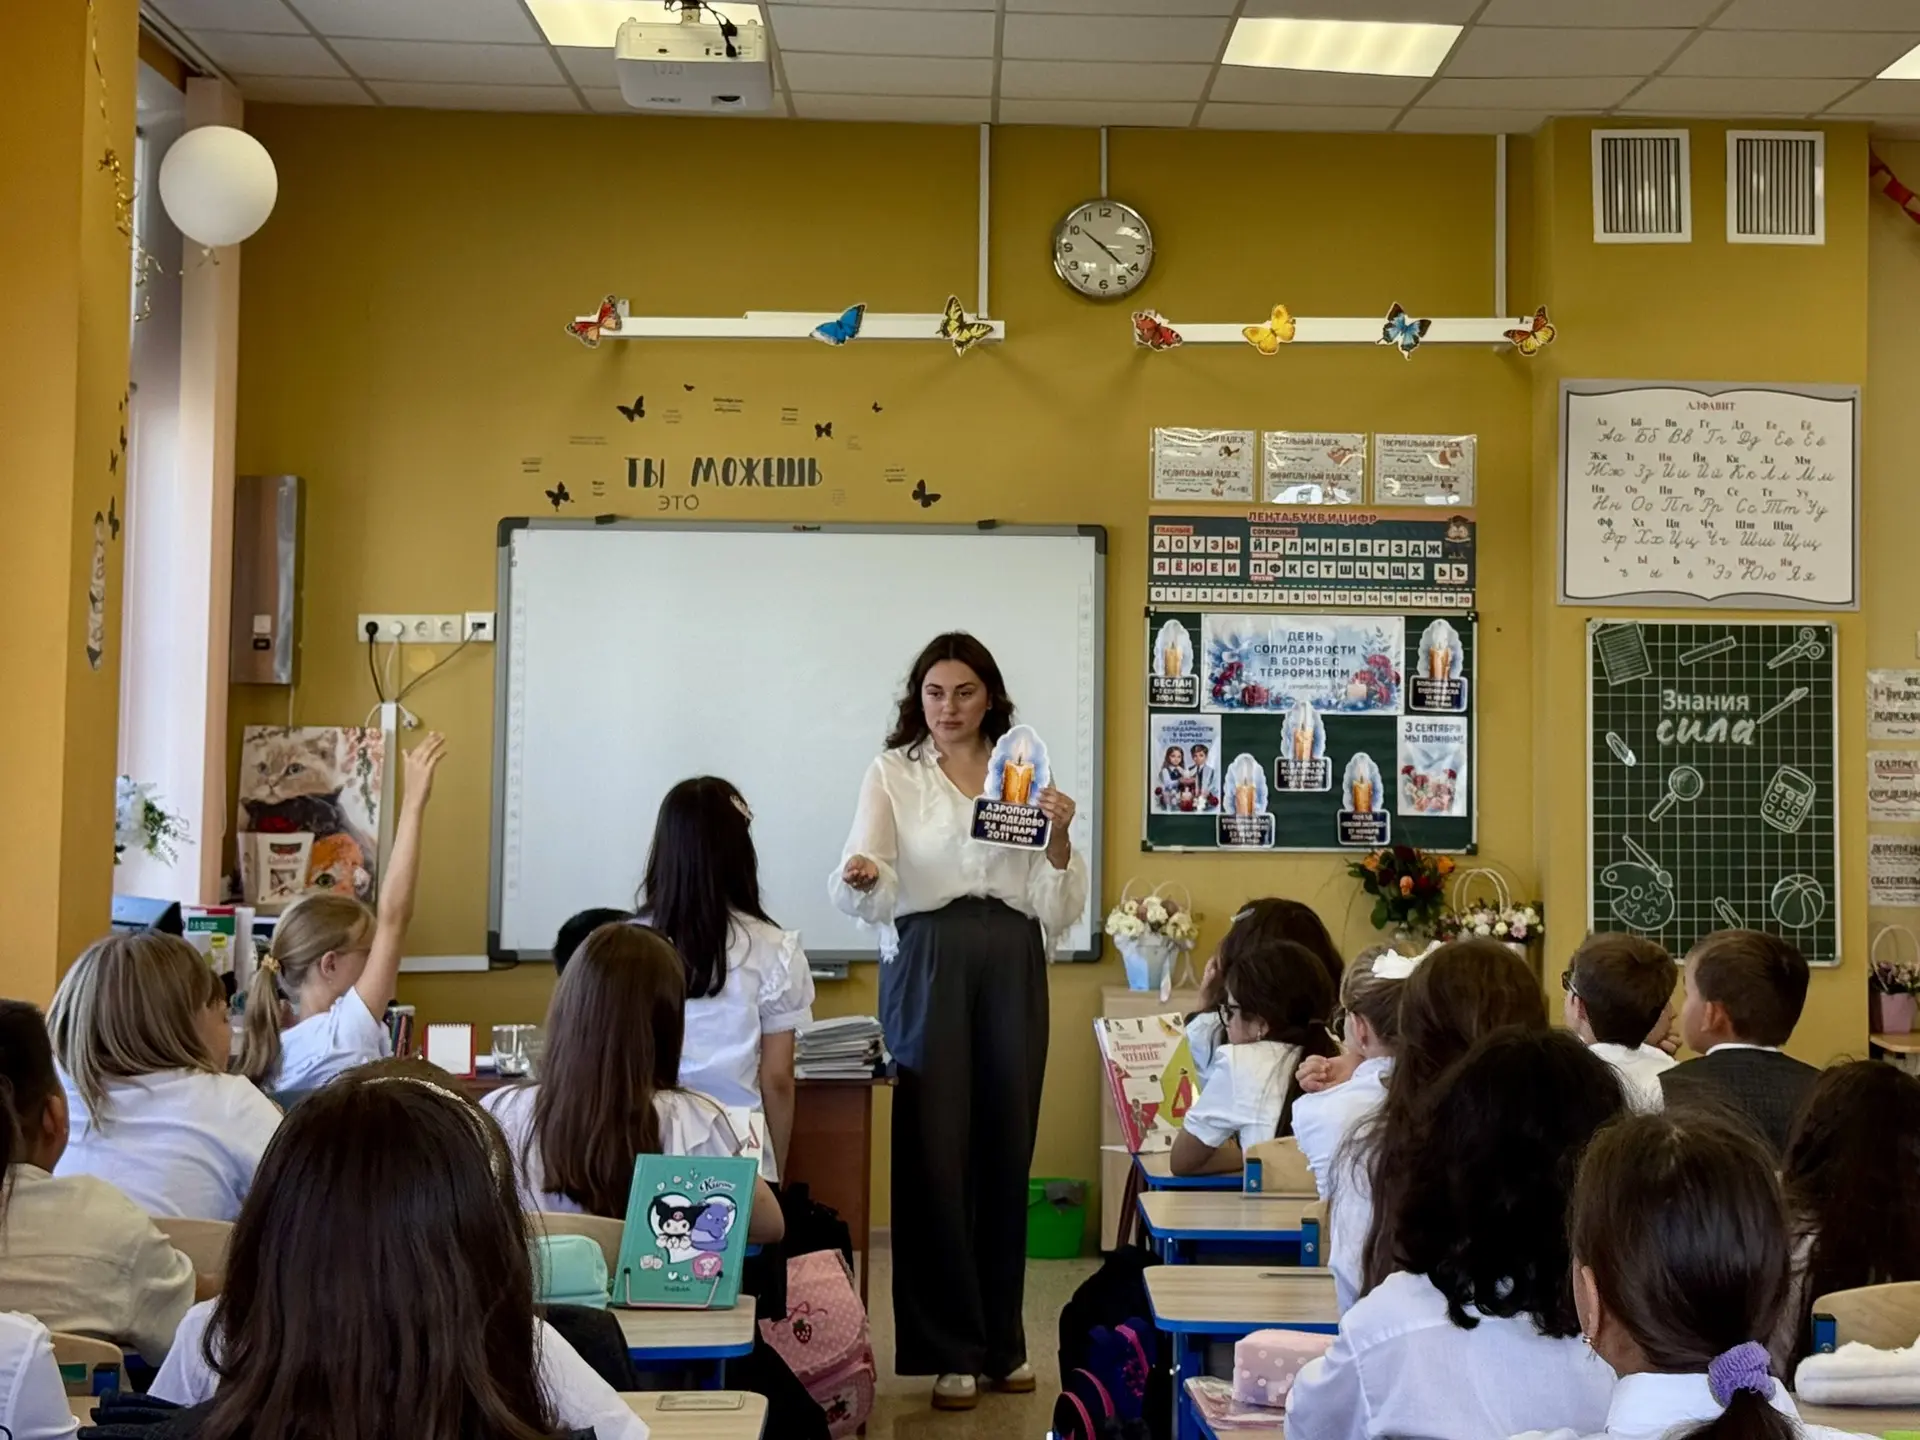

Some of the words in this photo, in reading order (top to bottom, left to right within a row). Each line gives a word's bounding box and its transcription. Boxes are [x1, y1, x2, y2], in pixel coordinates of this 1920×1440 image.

[1084, 212, 1091, 222] 11
[1099, 208, 1111, 217] 12
[1122, 213, 1125, 223] 1
[1070, 225, 1080, 235] 10
[1064, 243, 1073, 252] 9
[1136, 245, 1145, 255] 3
[1068, 261, 1079, 270] 8
[1131, 263, 1139, 272] 4
[1082, 274, 1090, 284] 7
[1099, 280, 1108, 289] 6
[1117, 276, 1126, 285] 5
[1686, 401, 1736, 411] АЛФАВИТ
[1598, 427, 1626, 443] Аа
[1635, 427, 1660, 444] Бб
[1668, 428, 1694, 444] Вв
[1703, 428, 1727, 445] Гг
[1737, 430, 1761, 451] Дд
[624, 456, 666, 489] ТЫ
[691, 457, 823, 488] МОЖЕШЬ
[1585, 462, 1625, 477] Жж
[1634, 464, 1654, 484] Зз
[1663, 463, 1690, 479] Ии
[1729, 464, 1757, 480] Кк
[1761, 465, 1790, 480] Лл
[1796, 466, 1835, 481] Мм
[658, 494, 699, 511] ЭТО
[1593, 495, 1622, 511] Нн
[1631, 496, 1653, 512] Оо
[1661, 496, 1694, 512] Пп
[1699, 497, 1723, 519] Рр
[1736, 498, 1757, 514] Сс
[1761, 499, 1800, 515] Тт
[1806, 500, 1828, 523] Уу
[1249, 512, 1290, 523] ЛЕНТА
[1292, 512, 1325, 523] БУКВ
[1329, 514, 1337, 523] И
[1339, 514, 1377, 525] ЦИФР
[1157, 539, 1167, 550] А
[1175, 539, 1184, 550] О
[1193, 540, 1201, 550] У
[1210, 540, 1219, 550] Э
[1226, 540, 1239, 550] Ы
[1601, 528, 1627, 552] Фф
[1634, 529, 1664, 545] Хх
[1670, 530, 1700, 549] Цц
[1707, 530, 1729, 546] Чч
[1740, 531, 1776, 547] Шш
[1783, 532, 1822, 551] Щщ
[1253, 539, 1263, 549] Й
[1272, 542, 1281, 551] Р
[1288, 542, 1298, 551] Л
[1305, 542, 1316, 552] М
[1324, 542, 1333, 552] Н
[1342, 543, 1350, 553] Б
[1360, 543, 1369, 553] В
[1378, 544, 1386, 553] Г
[1394, 544, 1403, 554] З
[1411, 544, 1422, 555] Д
[1427, 544, 1441, 554] Ж
[1157, 562, 1166, 571] Я
[1175, 560, 1183, 571] Ё
[1190, 562, 1202, 572] Ю
[1210, 562, 1218, 572] Е
[1227, 563, 1237, 573] И
[1253, 564, 1262, 573] П
[1269, 564, 1281, 574] Ф
[1289, 564, 1298, 574] К
[1306, 564, 1315, 574] С
[1324, 564, 1333, 575] Т
[1340, 565, 1351, 575] Ш
[1359, 566, 1368, 577] Ц
[1377, 566, 1385, 575] Ч
[1392, 567, 1405, 578] Щ
[1412, 566, 1421, 576] Х
[1713, 564, 1732, 580] Ээ
[1741, 565, 1776, 580] Юю
[1786, 566, 1816, 581] Яя
[1307, 593, 1317, 601] 10
[1353, 594, 1363, 602] 13
[1398, 595, 1409, 603] 16
[1287, 631, 1324, 642] ДЕНЬ
[1254, 645, 1356, 656] СОЛИДАРНОСТИ
[1270, 657, 1278, 666] В
[1282, 657, 1329, 666] БОРЬБЕ
[1332, 657, 1340, 667] С
[1260, 668, 1350, 679] ТЕРРОРИЗМОМ
[1154, 678, 1192, 688] БЕСЛАН
[1661, 688, 1751, 713] Знания
[1405, 721, 1413, 732] 3
[1415, 724, 1461, 733] СЕНТЯБРЯ
[1656, 715, 1757, 747] сила
[1404, 734, 1420, 743] МЫ
[986, 803, 1040, 817] АЭРОПОРТ
[979, 811, 1045, 827] ДОМОДЕДОВО
[984, 821, 997, 830] 24
[1000, 824, 1038, 836] ЯНВАРЯ
[987, 830, 1010, 840] 2011
